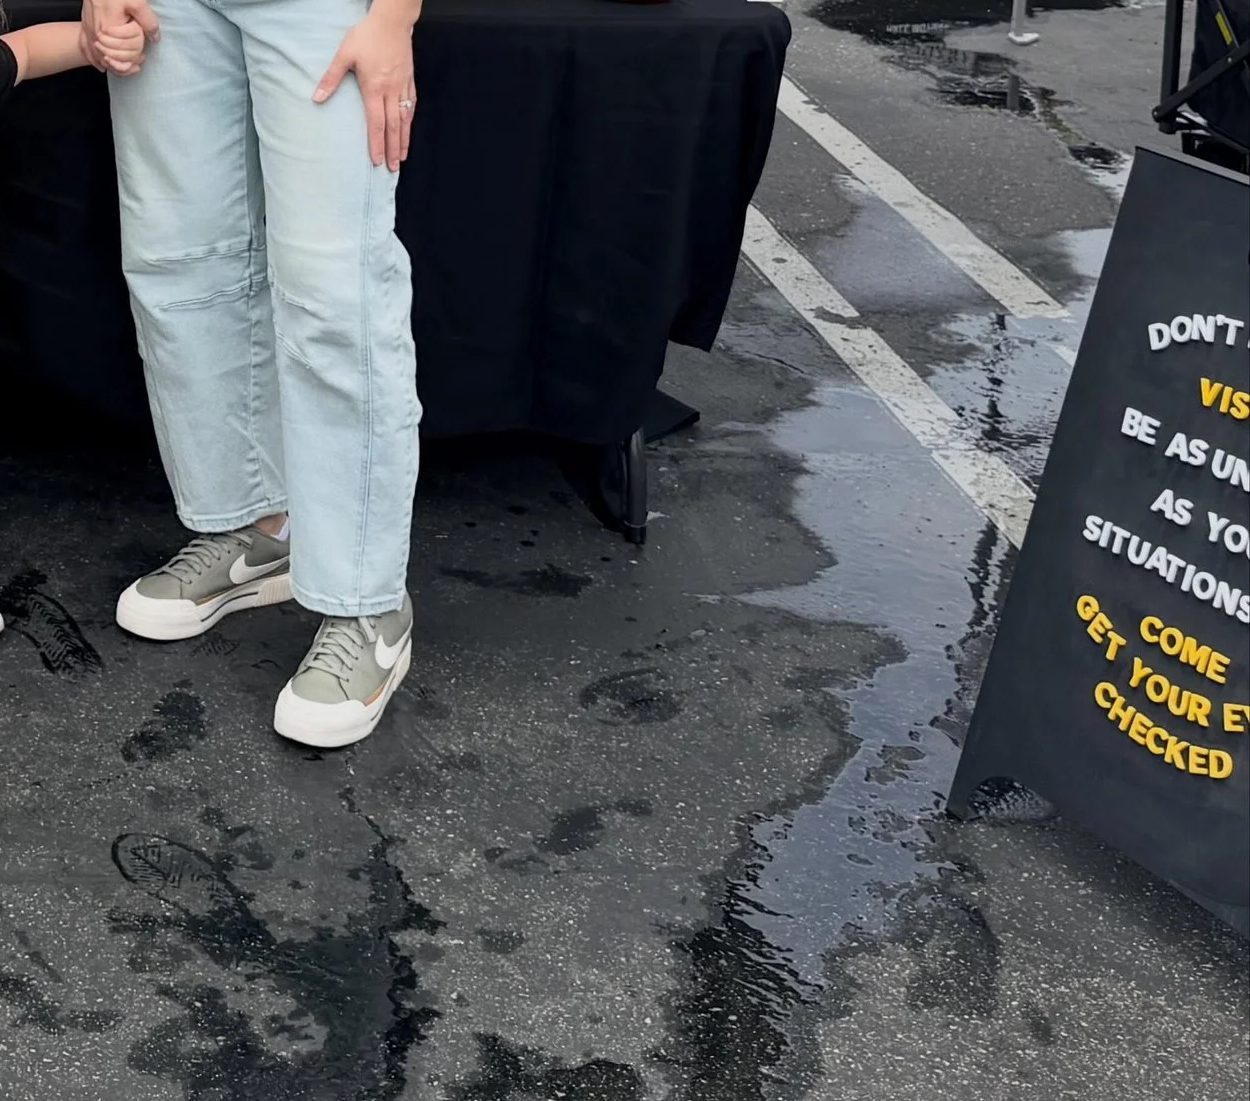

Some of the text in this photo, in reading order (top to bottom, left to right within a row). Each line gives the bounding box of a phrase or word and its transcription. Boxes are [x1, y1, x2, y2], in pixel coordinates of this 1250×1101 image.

[1148, 313, 1245, 351] DON'T
[1120, 406, 1162, 446] BE
[1164, 432, 1210, 467] AS
[1150, 488, 1250, 560] AS YO
[1076, 594, 1127, 662] GET
[1129, 656, 1213, 728] YOUR
[1139, 615, 1231, 685] COME
[1094, 681, 1234, 780] CHECKED
